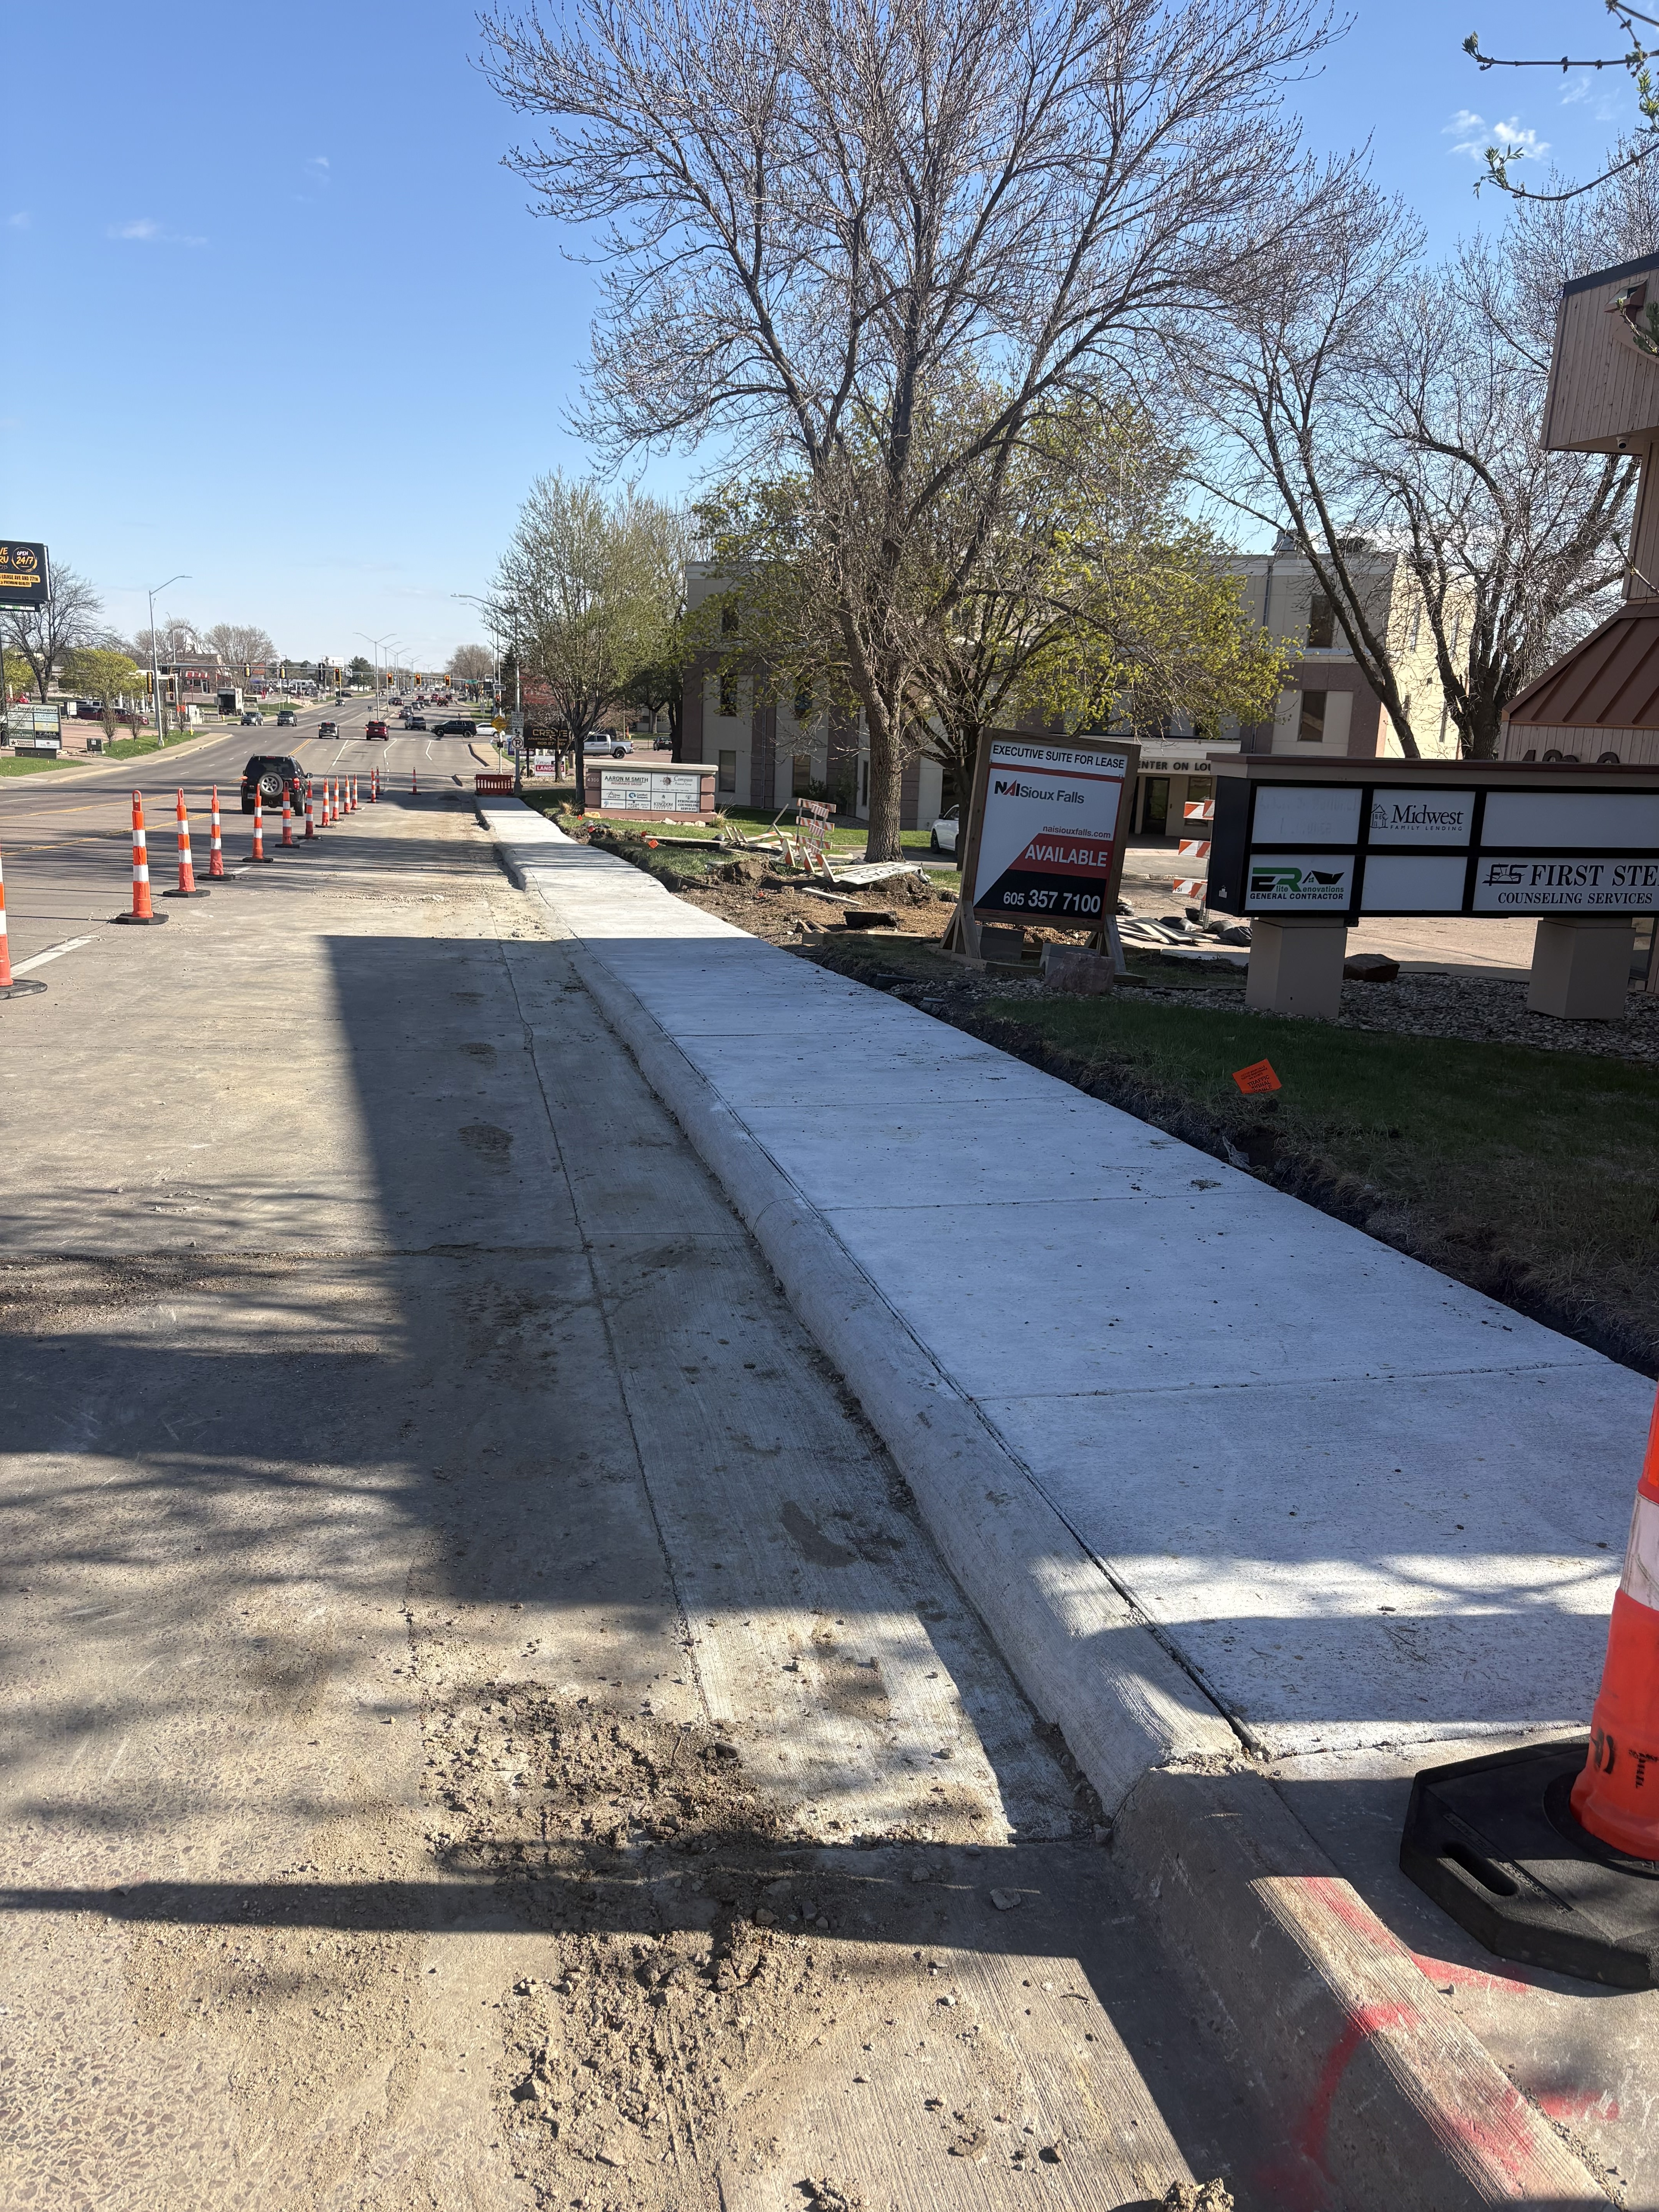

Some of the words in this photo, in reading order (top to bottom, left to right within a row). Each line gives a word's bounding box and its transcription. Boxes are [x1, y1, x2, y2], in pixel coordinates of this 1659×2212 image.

[16, 556, 34, 565] 24/7
[993, 745, 1044, 760] EXECUTIVE
[1046, 751, 1073, 763] SUITE
[1075, 754, 1093, 765] FOR
[1095, 756, 1125, 769] LEASE
[1173, 762, 1189, 770] ON
[674, 775, 693, 783] Compass
[1056, 790, 1085, 804] Falls
[1391, 804, 1464, 824] Midwest
[1042, 825, 1111, 839] naisiouxfalls.com
[1024, 844, 1108, 867] AVAILABLE
[860, 867, 900, 879] ROAD
[1529, 864, 1604, 886] FIRST
[1612, 865, 1659, 886] STE
[1003, 891, 1025, 906] 605
[1028, 889, 1058, 908] 357
[1063, 892, 1101, 913] 7100
[1498, 892, 1582, 904] COUNSELING
[1587, 892, 1653, 904] SERVICES
[1248, 1075, 1270, 1086] TRAFFIC
